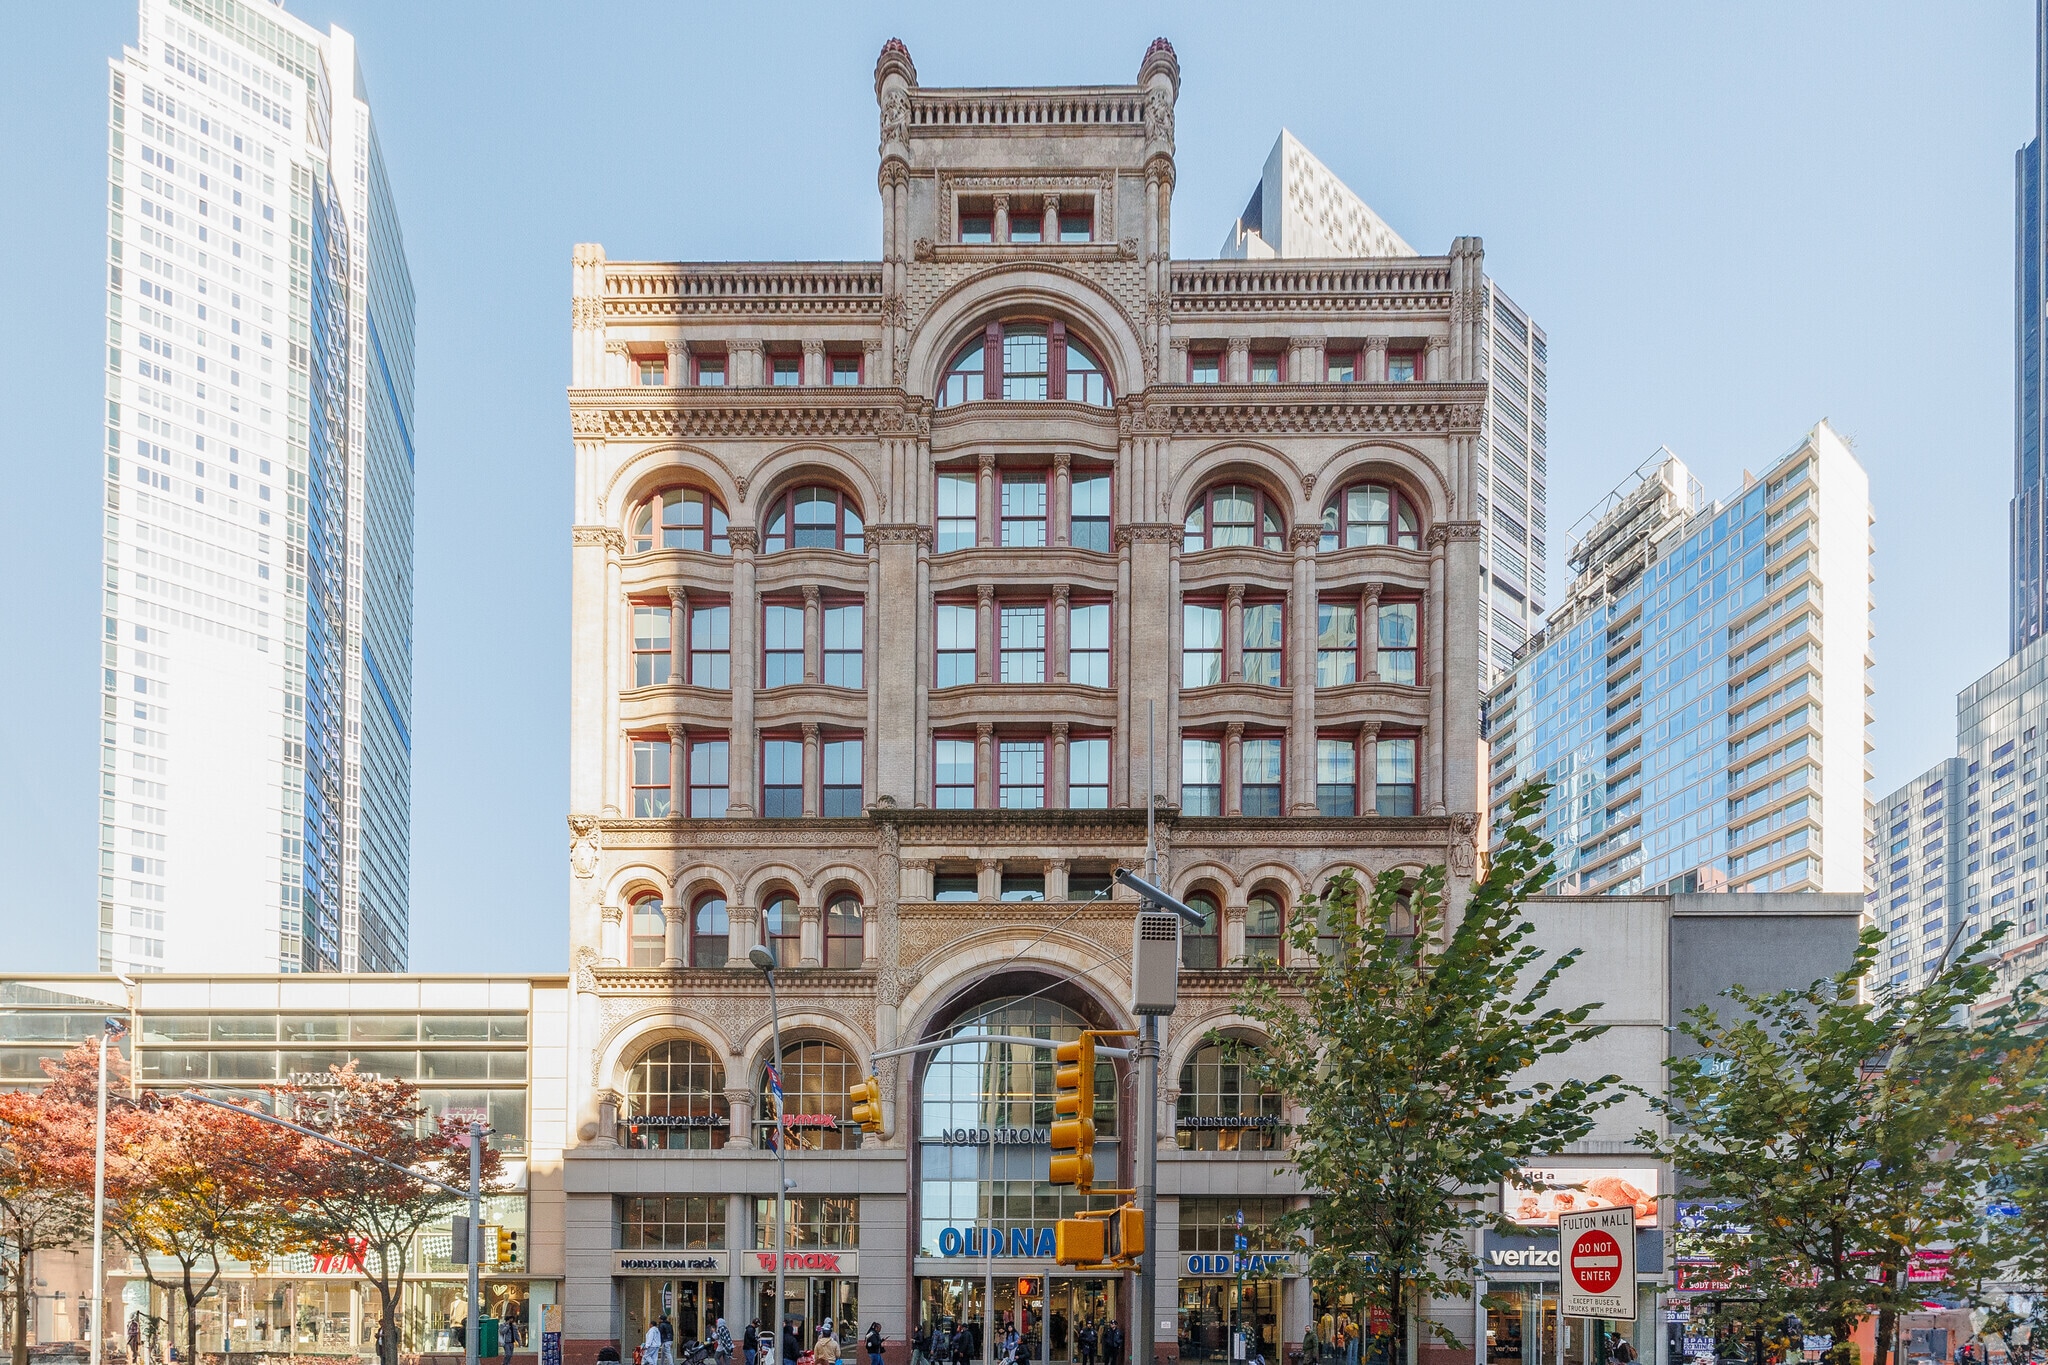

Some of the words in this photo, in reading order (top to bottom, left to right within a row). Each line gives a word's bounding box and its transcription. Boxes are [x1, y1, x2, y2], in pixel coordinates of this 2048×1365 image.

[1711, 1058, 1732, 1071] 517
[287, 1073, 381, 1086] NORDSOM
[444, 1109, 488, 1126] style
[628, 1115, 692, 1126] NORDSTROM
[693, 1112, 723, 1126] rack
[1184, 1116, 1250, 1127] NORDSTROM
[941, 1128, 1047, 1145] NORDSTROM
[1546, 1172, 1555, 1180] a
[1563, 1216, 1596, 1231] FULTON
[1601, 1213, 1629, 1228] MALL
[938, 1227, 1005, 1258] OLD
[1010, 1227, 1057, 1258] NA
[1578, 1243, 1591, 1254] DO
[1593, 1241, 1612, 1253] NOT
[621, 1259, 687, 1269] NORDSTROM
[687, 1256, 719, 1269] rack
[1490, 1245, 1560, 1267] verizo
[1188, 1254, 1231, 1274] OLD
[1580, 1270, 1611, 1281] ENTER
[1572, 1297, 1593, 1305] EXCEPT
[1594, 1298, 1614, 1306] BUSES
[1616, 1299, 1621, 1307] &
[1568, 1304, 1589, 1313] TRUCKS
[1605, 1306, 1628, 1315] PERMIT
